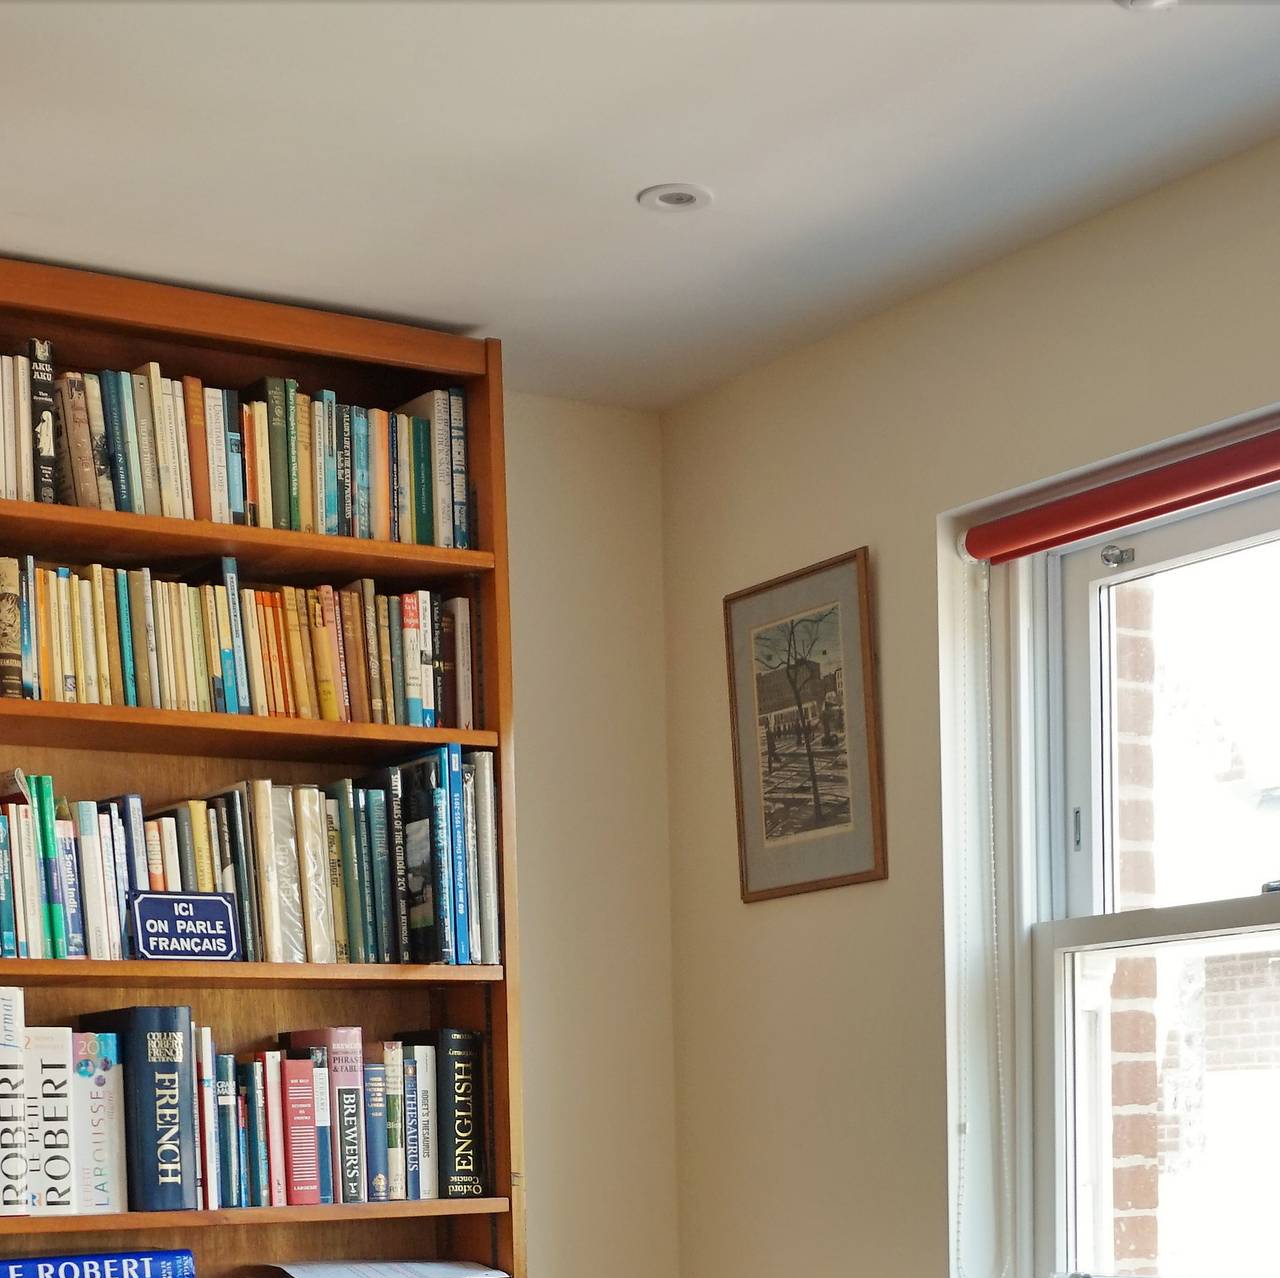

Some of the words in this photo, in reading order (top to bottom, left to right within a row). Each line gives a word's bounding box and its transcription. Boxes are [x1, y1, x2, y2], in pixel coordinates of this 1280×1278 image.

[119, 466, 127, 499] SIBERIA
[392, 797, 402, 819] YEARS
[393, 820, 402, 829] OF
[394, 831, 403, 844] THE
[455, 830, 463, 854] Dieppe
[65, 853, 77, 886] South
[456, 862, 465, 888] d'Alpine
[397, 877, 406, 891] 2CV
[67, 888, 79, 914] India
[174, 902, 194, 916] ICI
[399, 899, 407, 915] JOHN
[145, 919, 169, 933] ON
[176, 920, 226, 934] PARLE
[149, 936, 227, 953] FRANÇAIS
[422, 1089, 430, 1117] ROGET'S
[27, 1097, 40, 1142] PETIT
[154, 1071, 182, 1184] FRENCH
[454, 1061, 474, 1172] ENGLISH
[40, 1058, 71, 1207] ROBERT
[343, 1093, 360, 1178] BREWER'S
[407, 1091, 418, 1171] THESAURUS
[422, 1119, 430, 1158] THESAURUS
[90, 1091, 110, 1207] LAROUSSE
[29, 1153, 41, 1172] LE
[448, 1183, 483, 1195] Oxford
